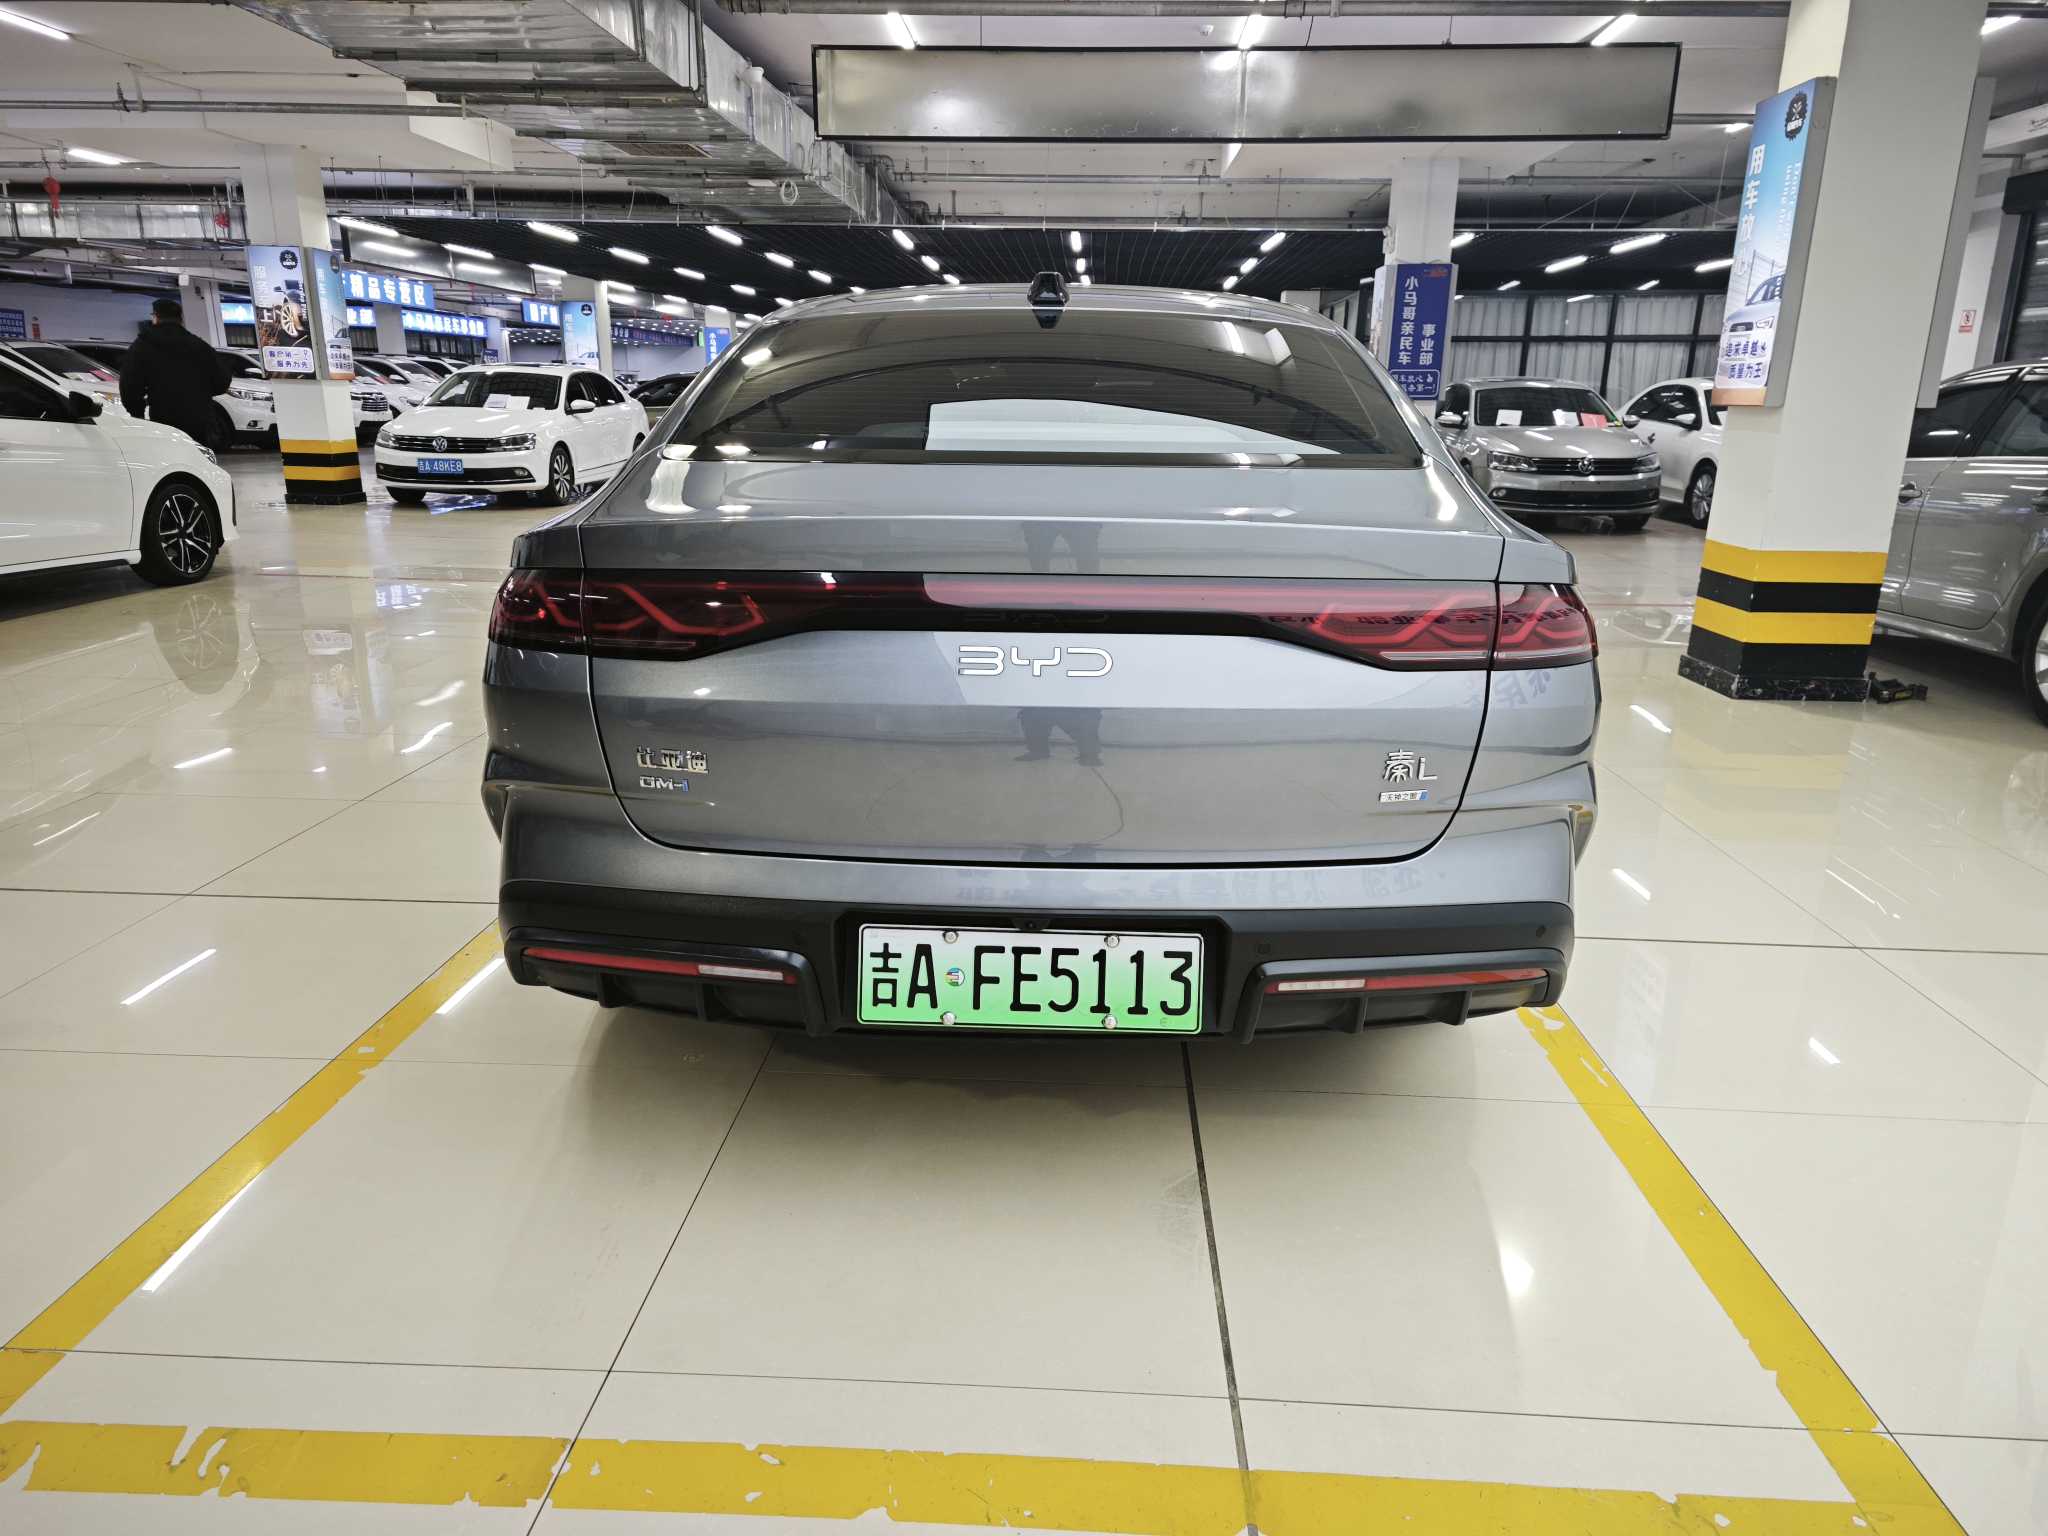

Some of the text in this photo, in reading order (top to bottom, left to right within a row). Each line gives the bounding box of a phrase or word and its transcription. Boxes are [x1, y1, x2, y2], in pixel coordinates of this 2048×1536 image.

[1397, 276, 1419, 365] 小马哥亲民车
[1419, 323, 1437, 366] 事业部
[1725, 340, 1760, 358] 追求卓越
[958, 645, 1114, 678] BYD
[636, 746, 709, 774] 比亚迪
[1383, 748, 1438, 784] 秦L
